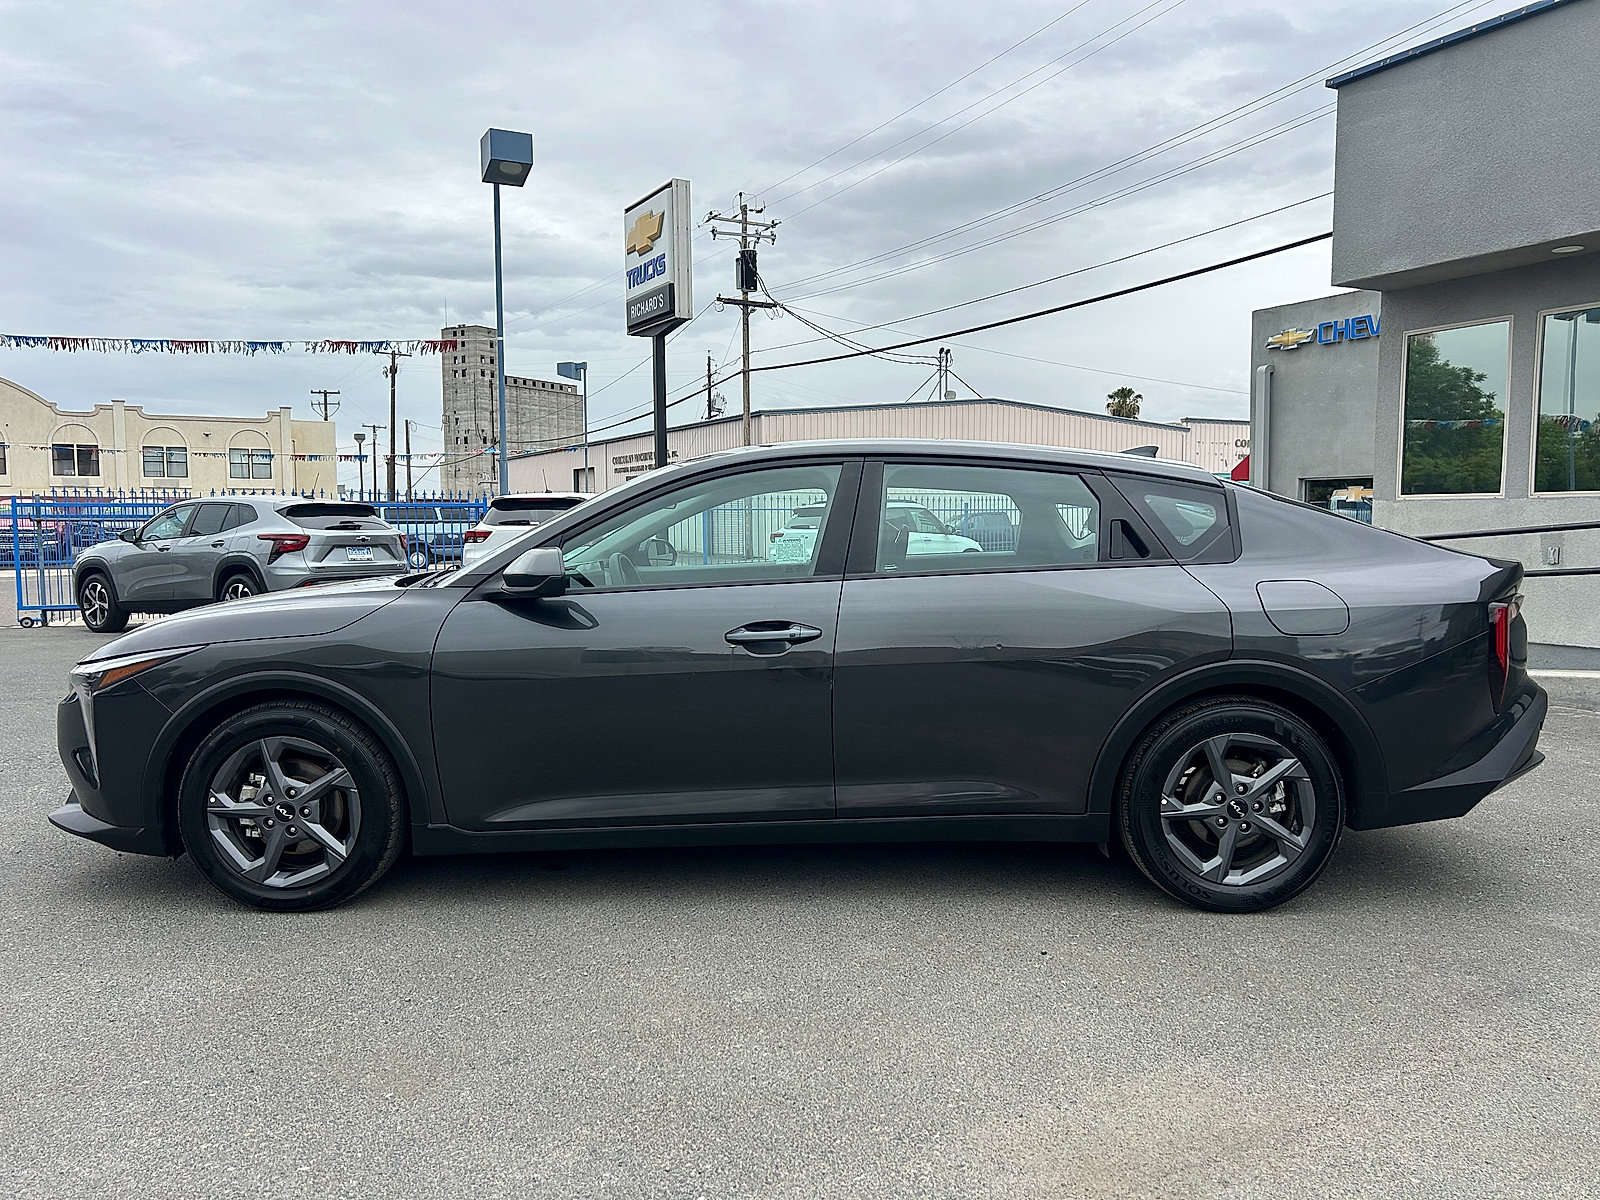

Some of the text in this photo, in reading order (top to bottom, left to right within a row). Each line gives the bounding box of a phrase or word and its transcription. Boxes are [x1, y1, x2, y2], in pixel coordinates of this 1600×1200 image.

[626, 252, 666, 290] TRUCKS
[630, 293, 664, 319] RICHARD'S
[1317, 314, 1381, 344] CHEV
